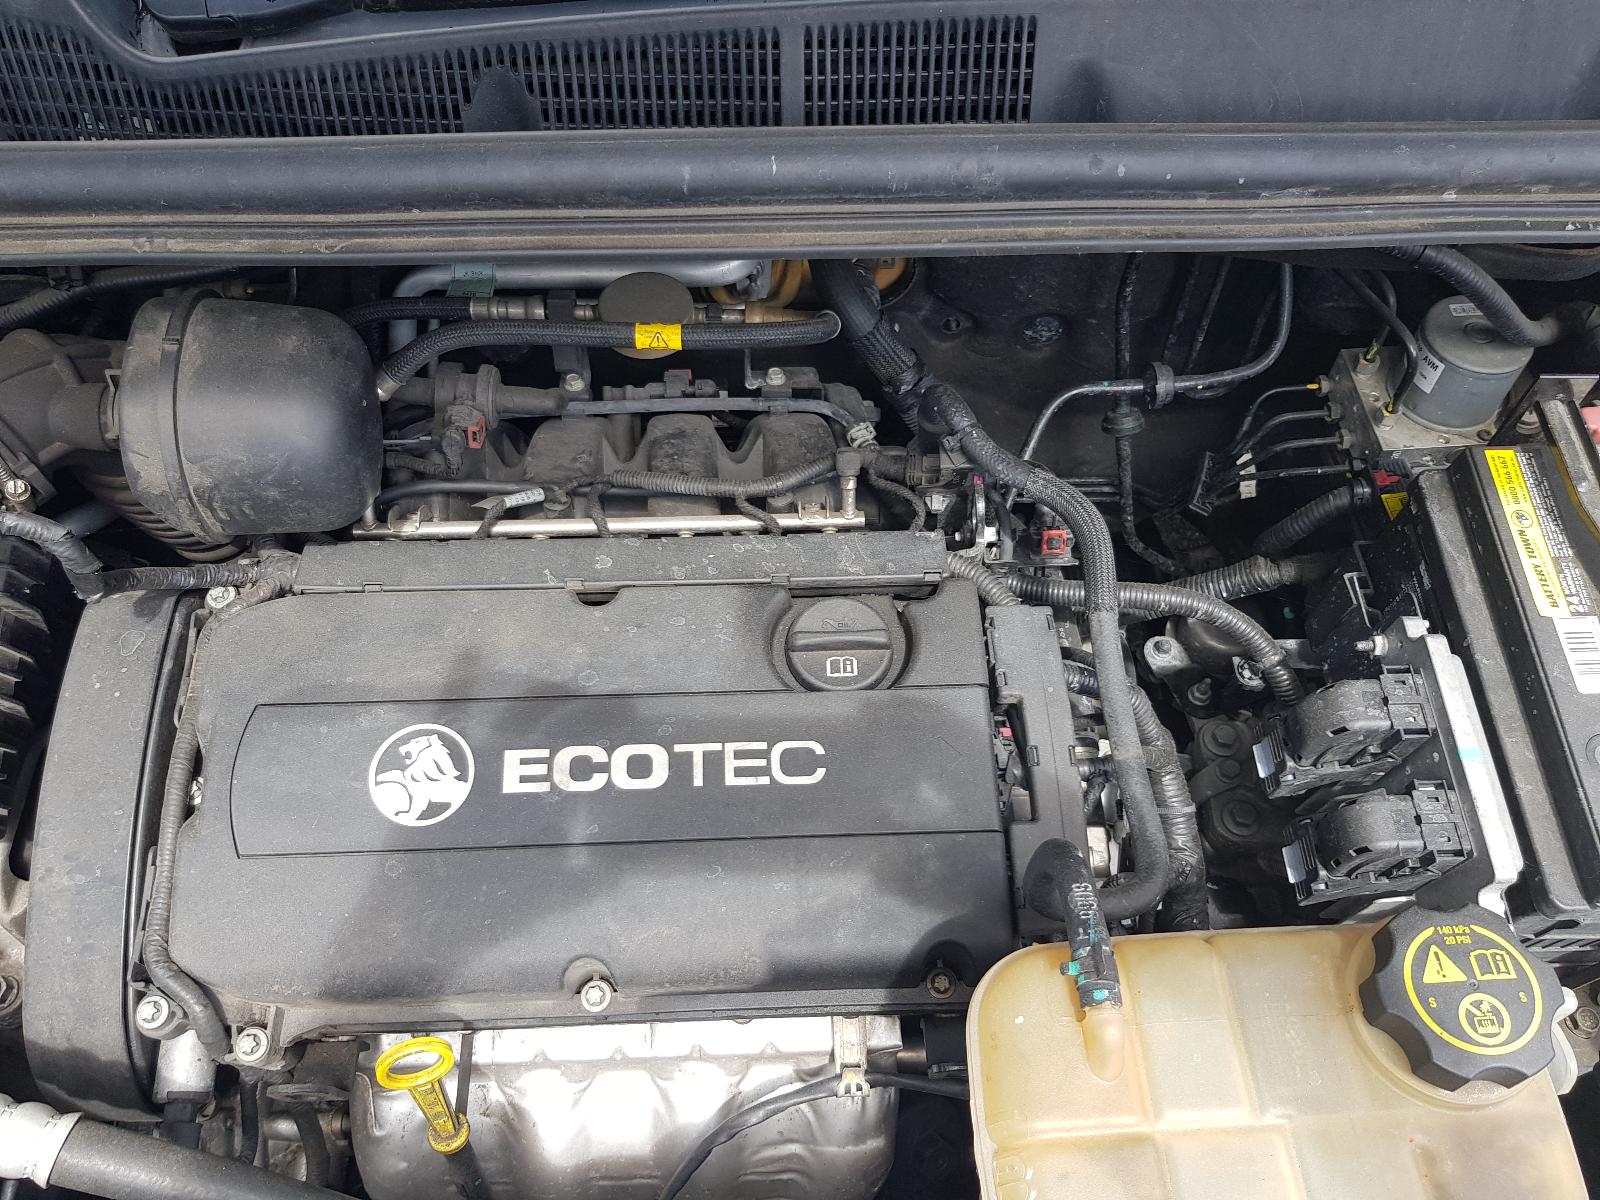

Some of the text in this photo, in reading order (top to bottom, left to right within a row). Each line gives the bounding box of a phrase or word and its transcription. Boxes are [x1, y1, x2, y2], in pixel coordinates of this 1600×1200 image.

[1422, 355, 1439, 372] AVM
[1498, 455, 1509, 469] 667
[1503, 470, 1514, 485] 566
[1516, 528, 1537, 559] TOWN
[1532, 563, 1559, 609] BATTERY
[502, 740, 827, 794] ECOTEC
[1436, 925, 1471, 935] 140 kPa
[1444, 935, 1472, 945] 20 PSI
